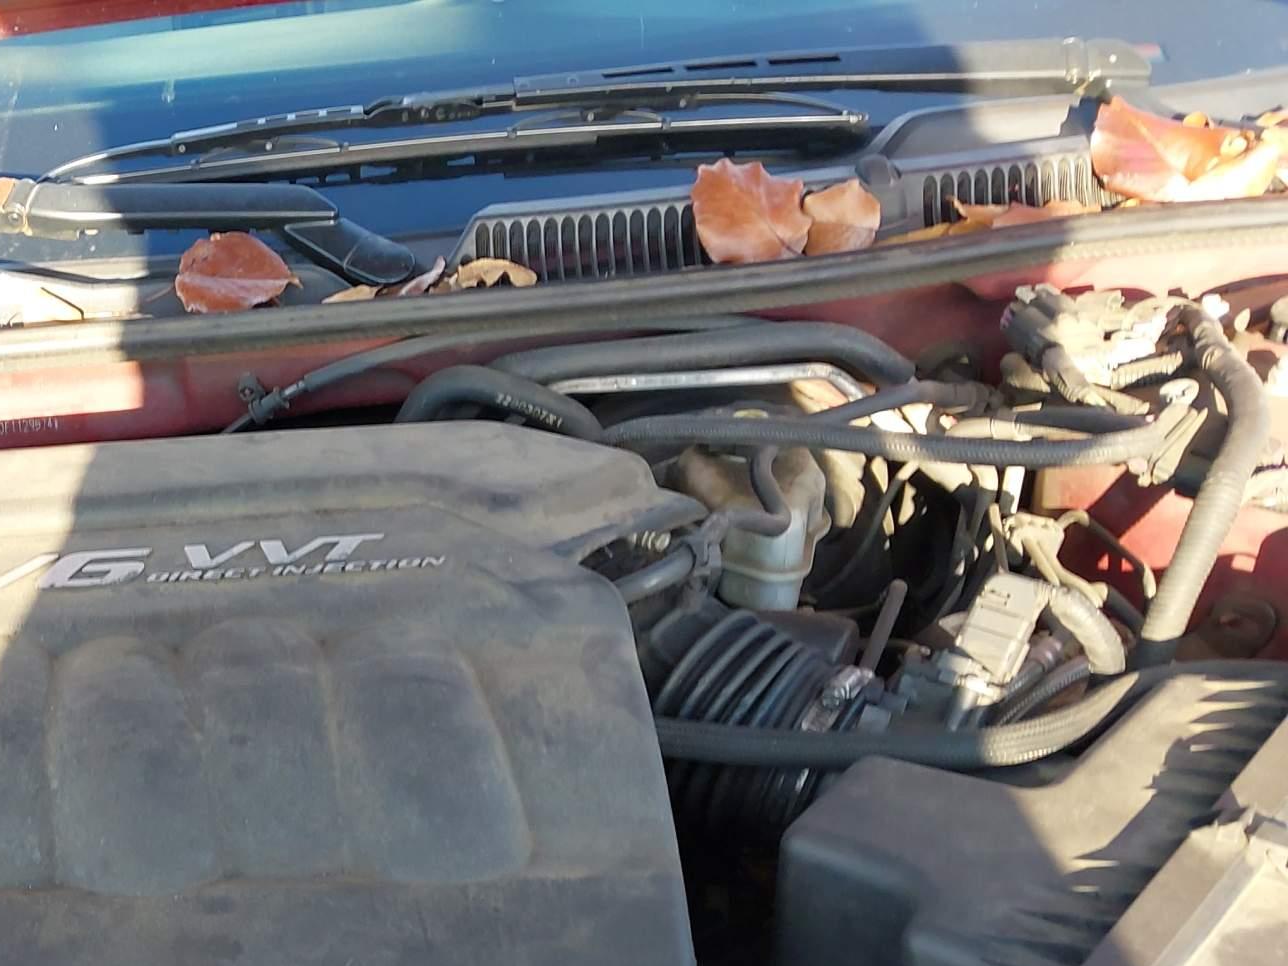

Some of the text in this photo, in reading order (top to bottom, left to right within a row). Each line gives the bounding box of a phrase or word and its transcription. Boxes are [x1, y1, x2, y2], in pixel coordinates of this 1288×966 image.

[184, 533, 384, 569] VVT
[147, 556, 446, 583] DIRECT INJECTION
